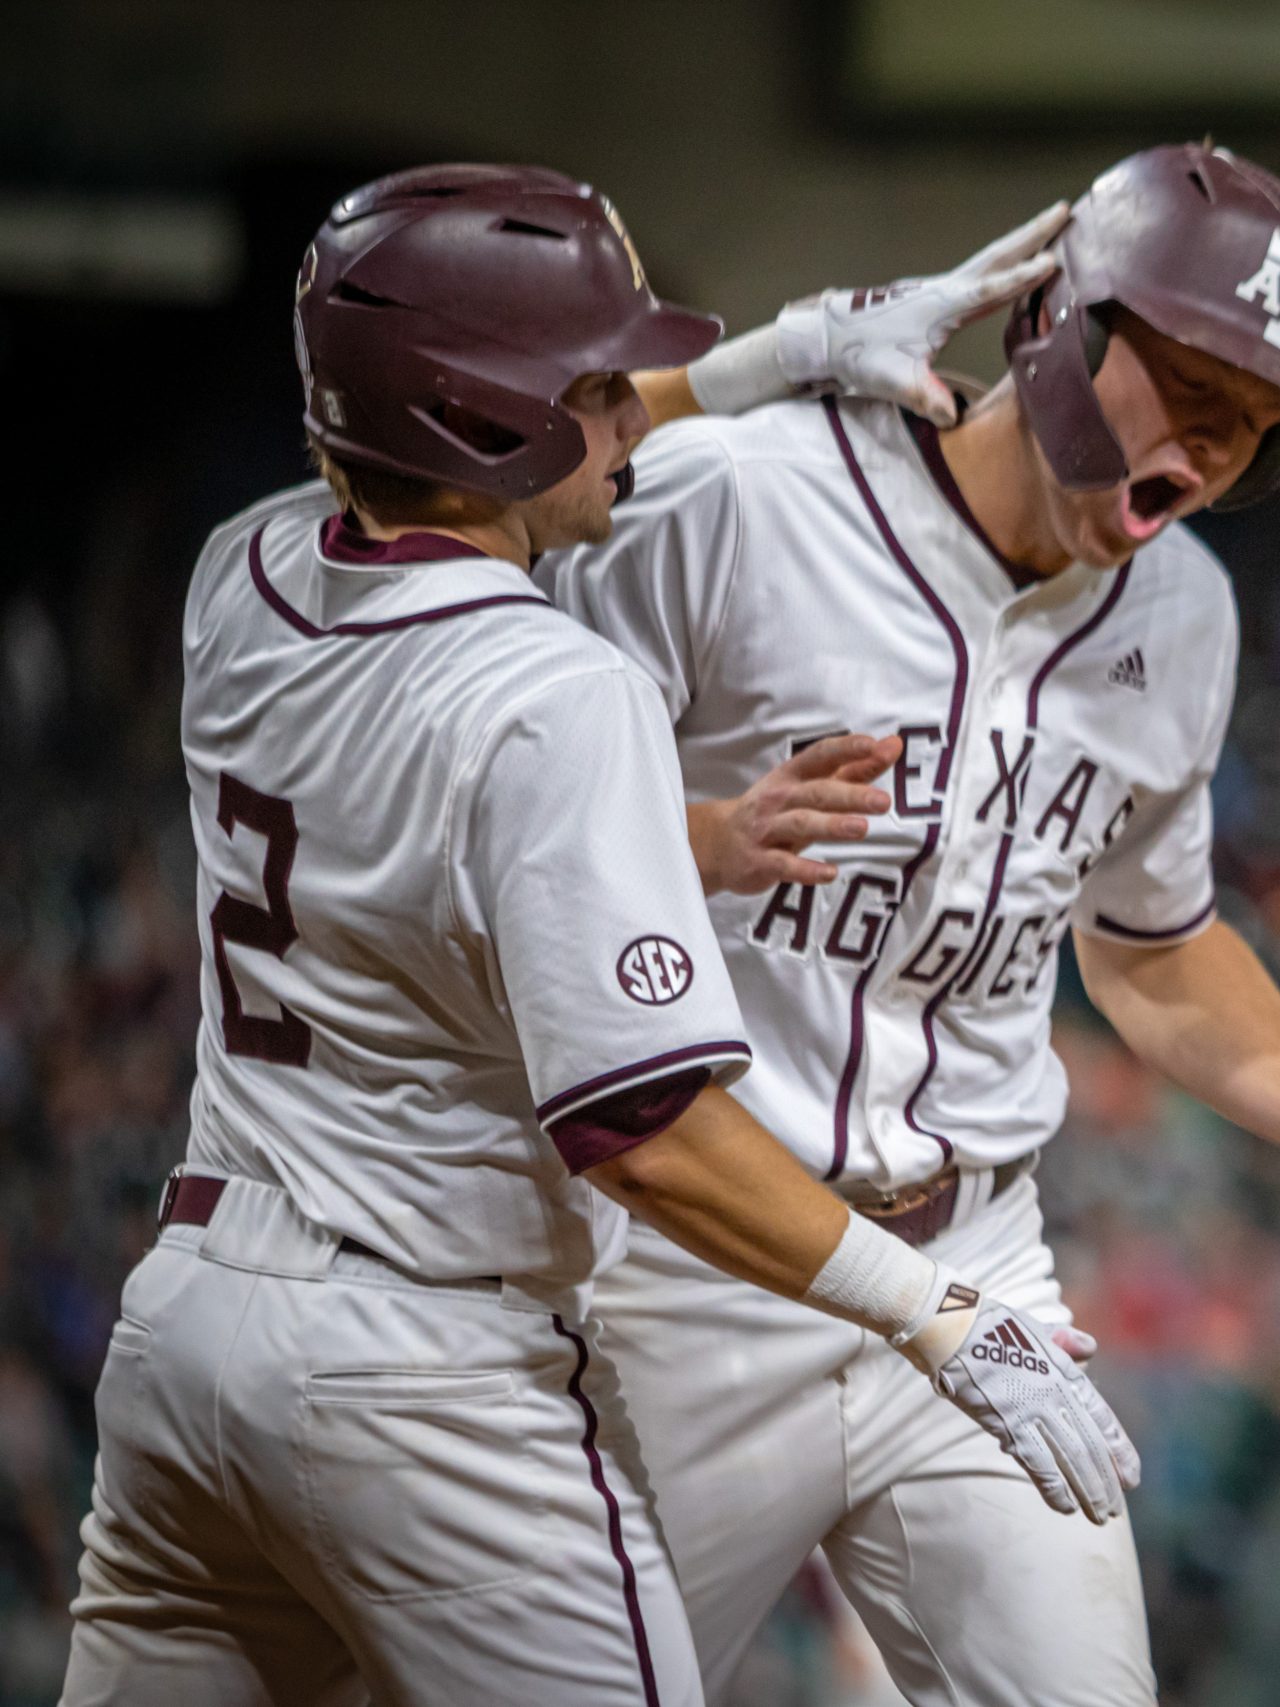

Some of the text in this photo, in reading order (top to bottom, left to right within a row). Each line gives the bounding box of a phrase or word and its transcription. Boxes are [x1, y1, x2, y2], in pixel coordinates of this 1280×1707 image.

[791, 725, 1134, 878] EXA
[210, 771, 312, 1068] 2
[619, 937, 691, 1003] SEC
[971, 1343, 1050, 1375] adidas
